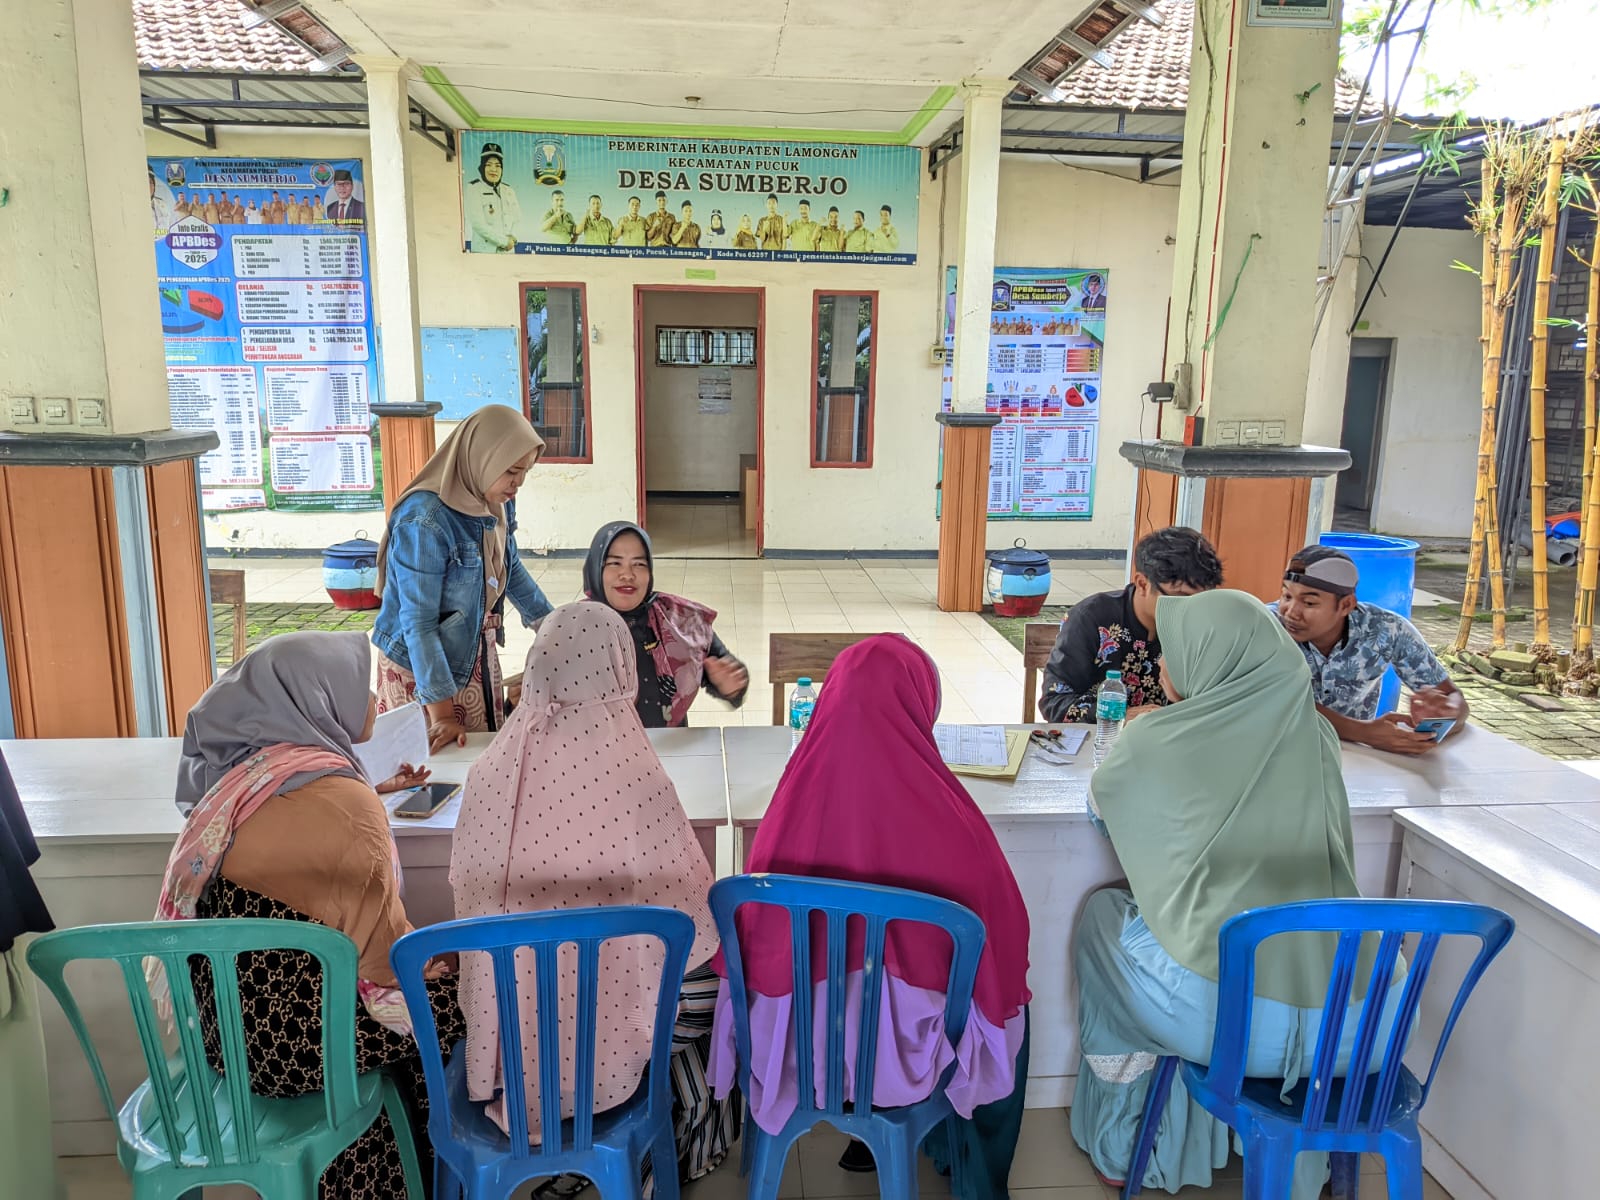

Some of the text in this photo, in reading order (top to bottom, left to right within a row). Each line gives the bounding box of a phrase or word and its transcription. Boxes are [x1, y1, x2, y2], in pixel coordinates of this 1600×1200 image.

[609, 141, 857, 158] PEMERINTAH KABUPATEN LAMONGAN
[669, 158, 799, 171] KECAMATAN PUCUK
[205, 174, 297, 183] DESA SUMBERJO
[618, 170, 847, 195] DESA SUMBERJO
[172, 235, 216, 247] APBDes
[646, 248, 669, 256] Pucuk,
[185, 255, 207, 263] 2025
[1031, 293, 1067, 301] Sumberjo
